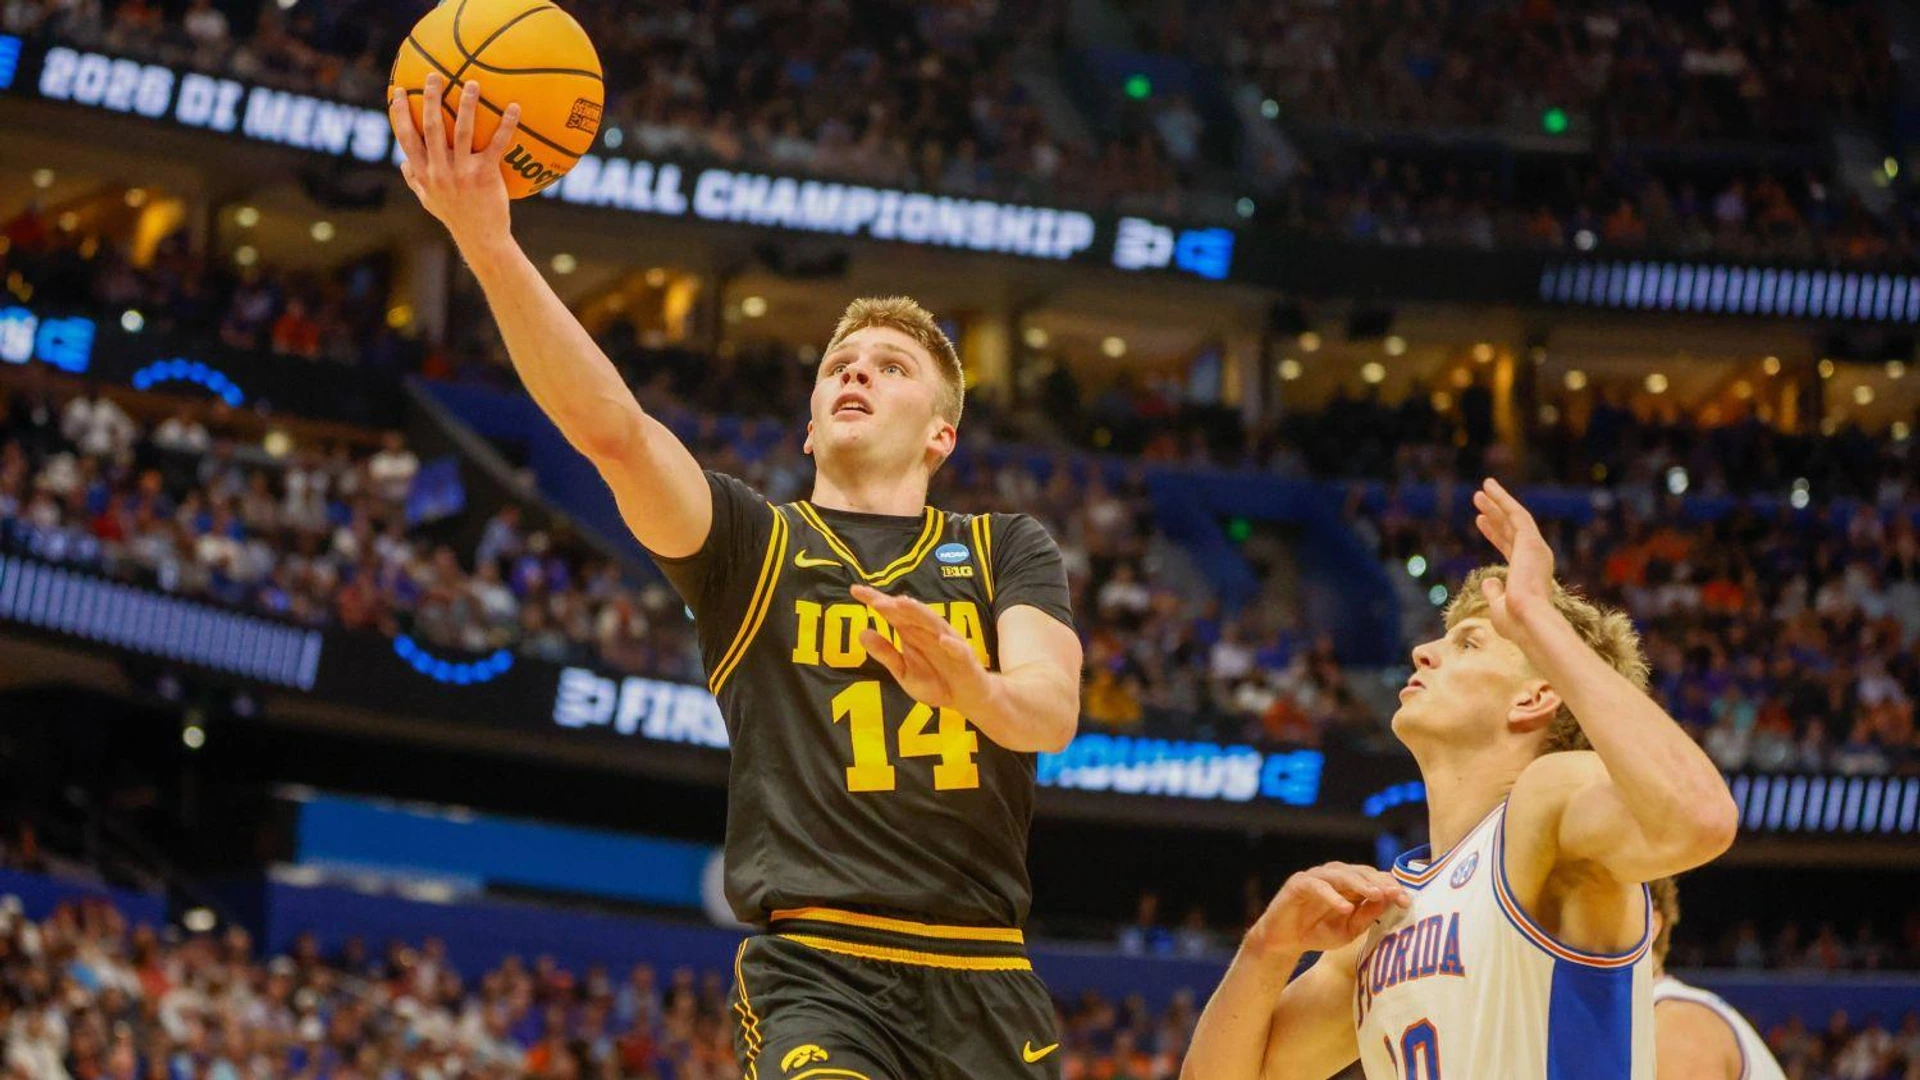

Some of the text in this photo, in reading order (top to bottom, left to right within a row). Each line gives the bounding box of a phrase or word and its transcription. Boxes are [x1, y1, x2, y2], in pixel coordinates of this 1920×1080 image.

[693, 167, 1095, 260] CHAMPIONSHIP
[615, 675, 731, 749] FIRS
[831, 680, 979, 792] 14
